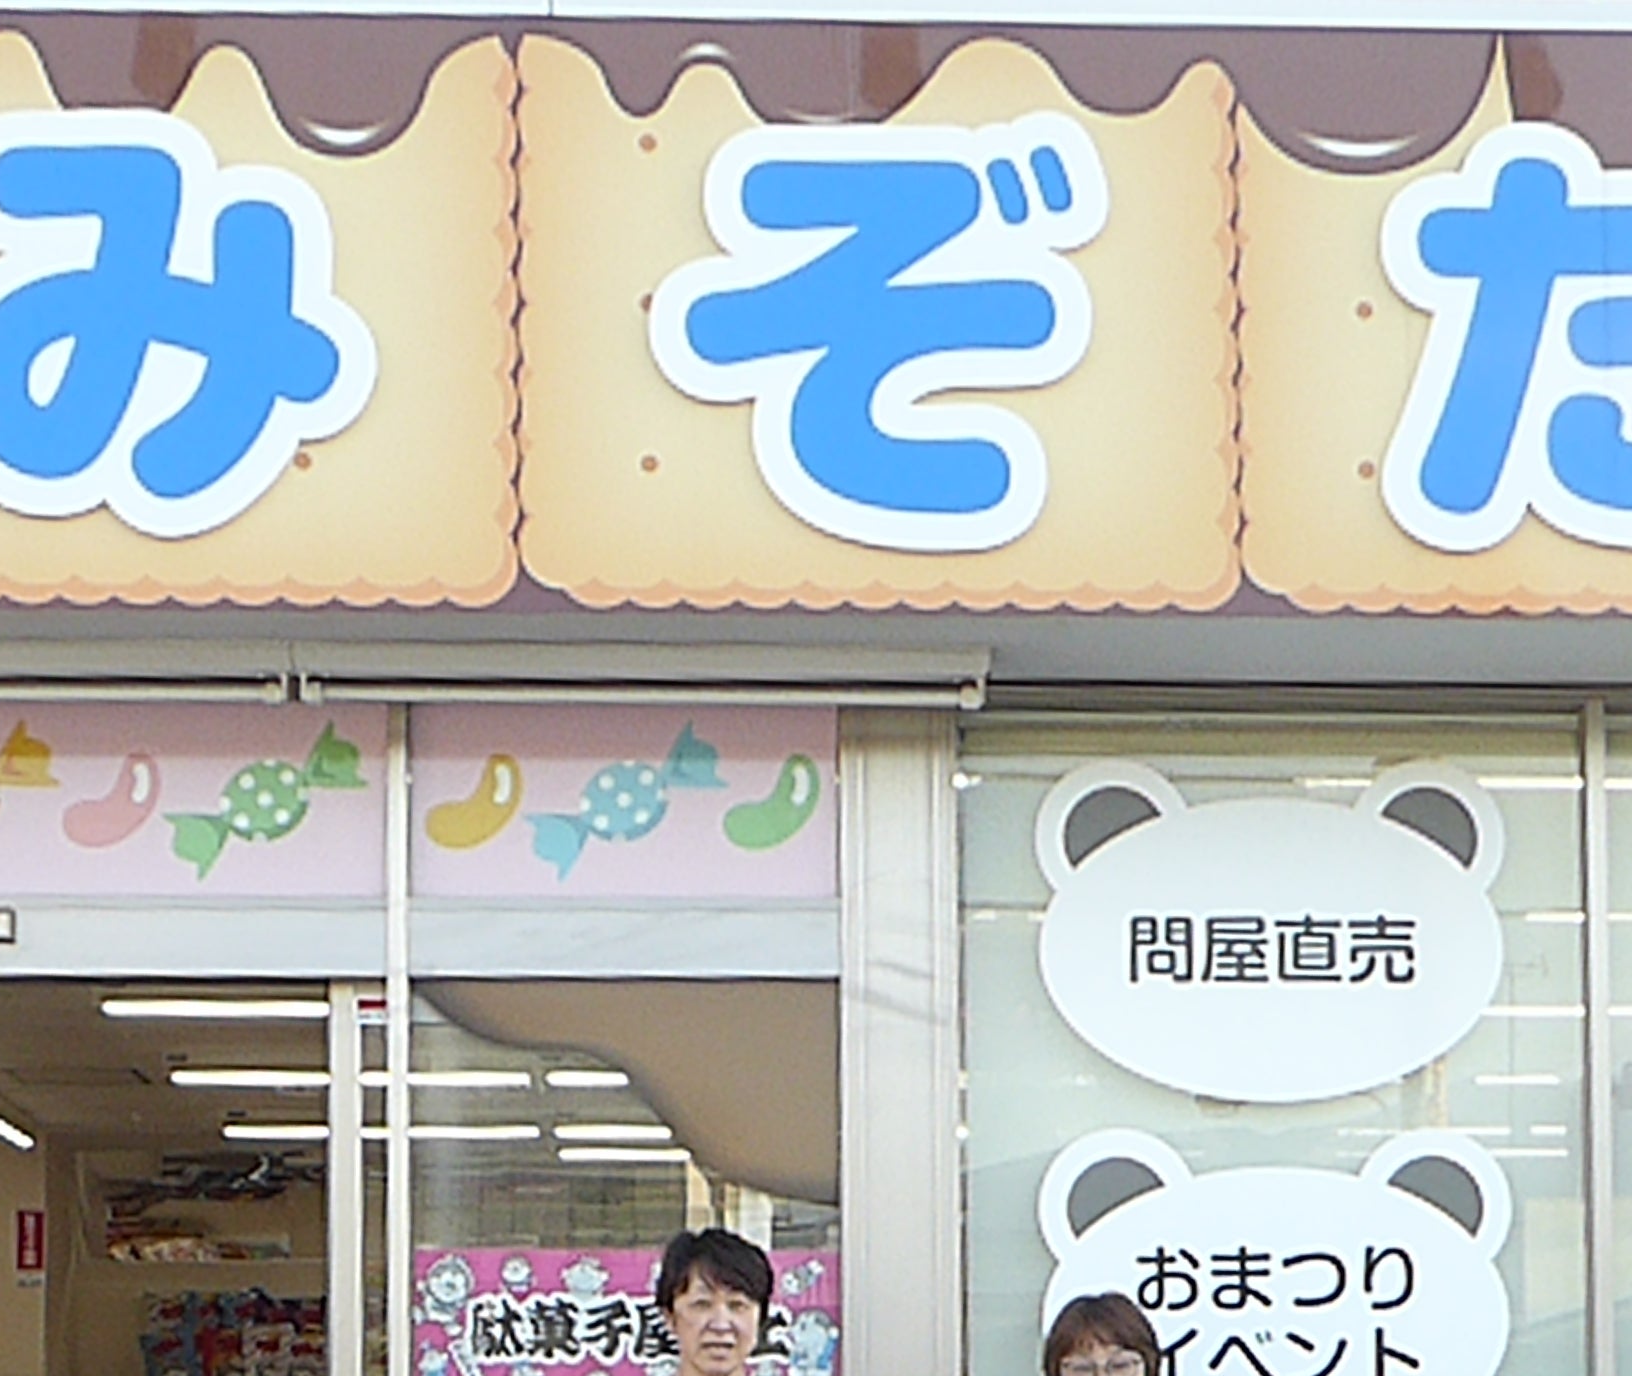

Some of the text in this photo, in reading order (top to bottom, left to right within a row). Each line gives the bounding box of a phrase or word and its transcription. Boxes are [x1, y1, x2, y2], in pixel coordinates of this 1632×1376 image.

[1130, 915, 1417, 984] 問屋直売
[1136, 1246, 1414, 1311] おまつり
